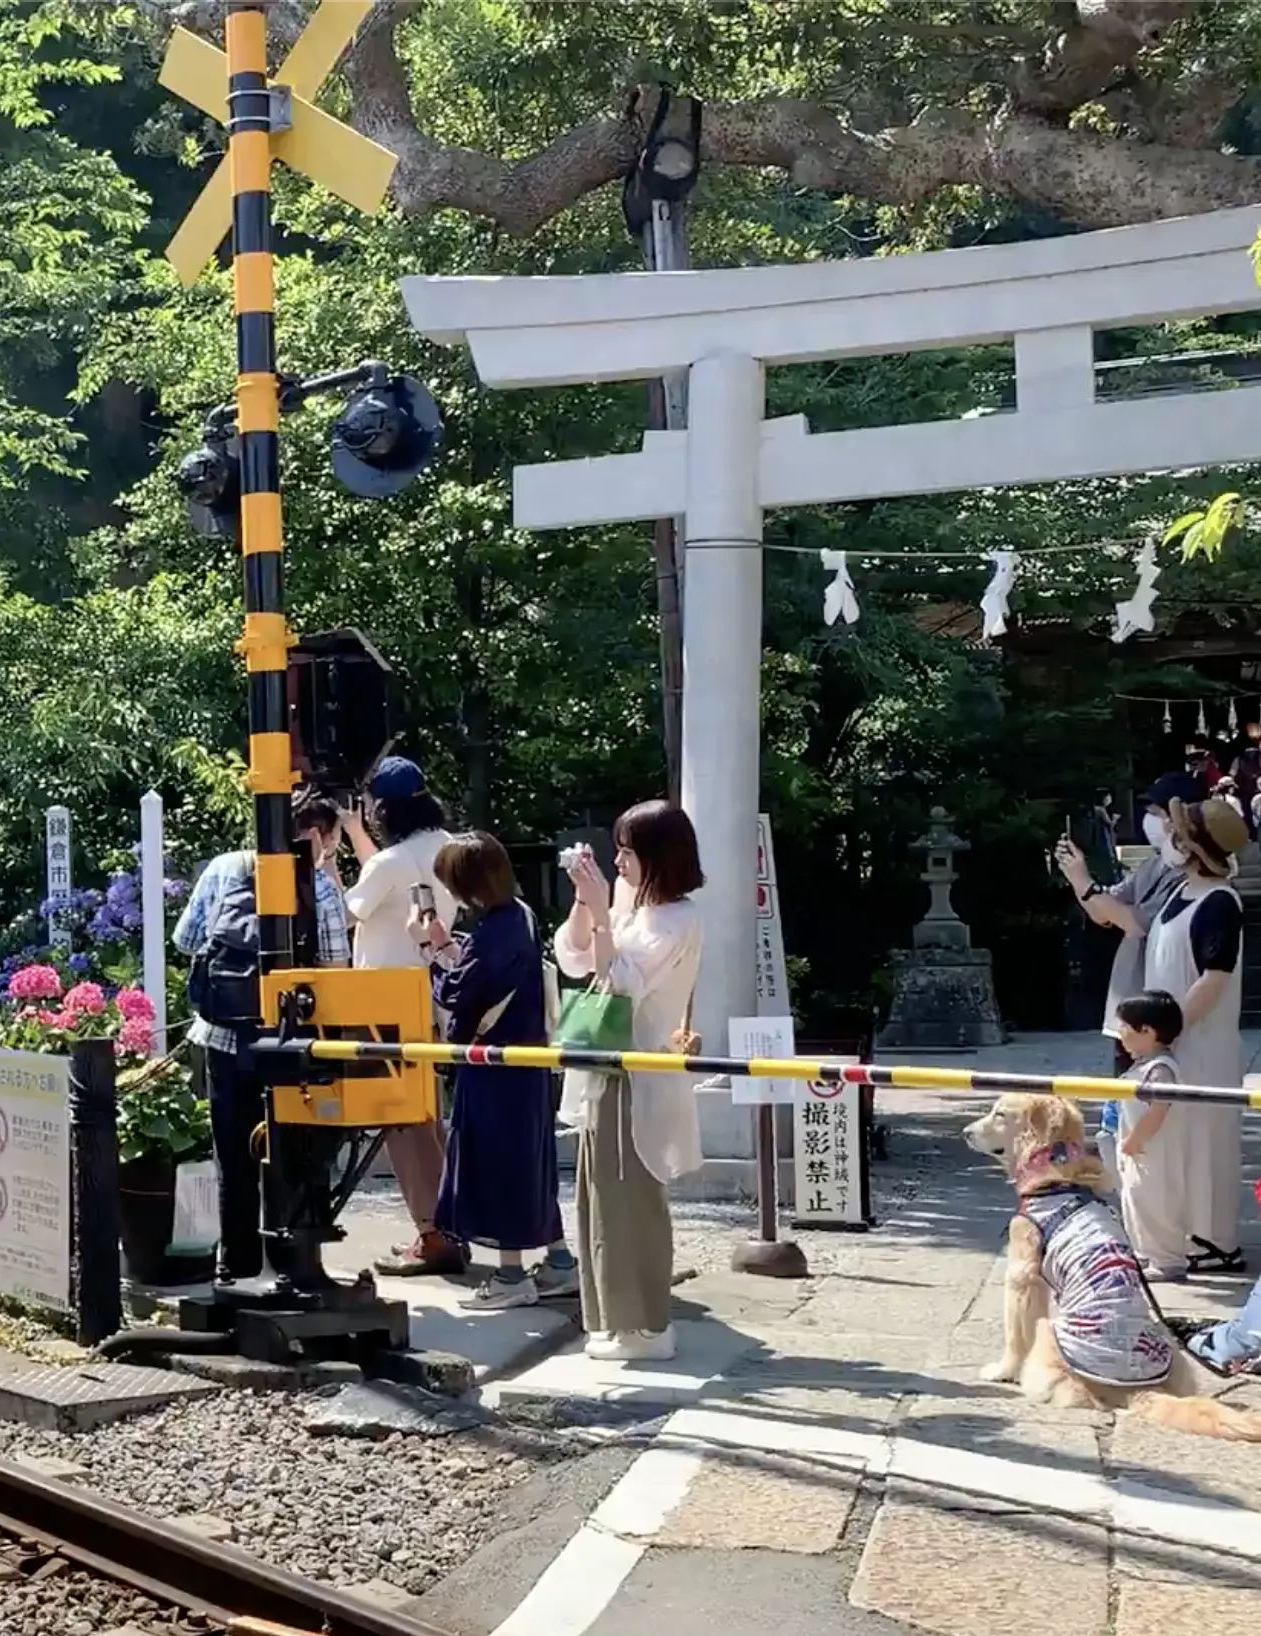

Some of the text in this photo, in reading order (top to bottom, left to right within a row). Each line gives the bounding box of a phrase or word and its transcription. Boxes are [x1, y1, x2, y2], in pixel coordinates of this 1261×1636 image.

[49, 817, 67, 944] 鎌倉市
[802, 1101, 832, 1213] 撮影禁止
